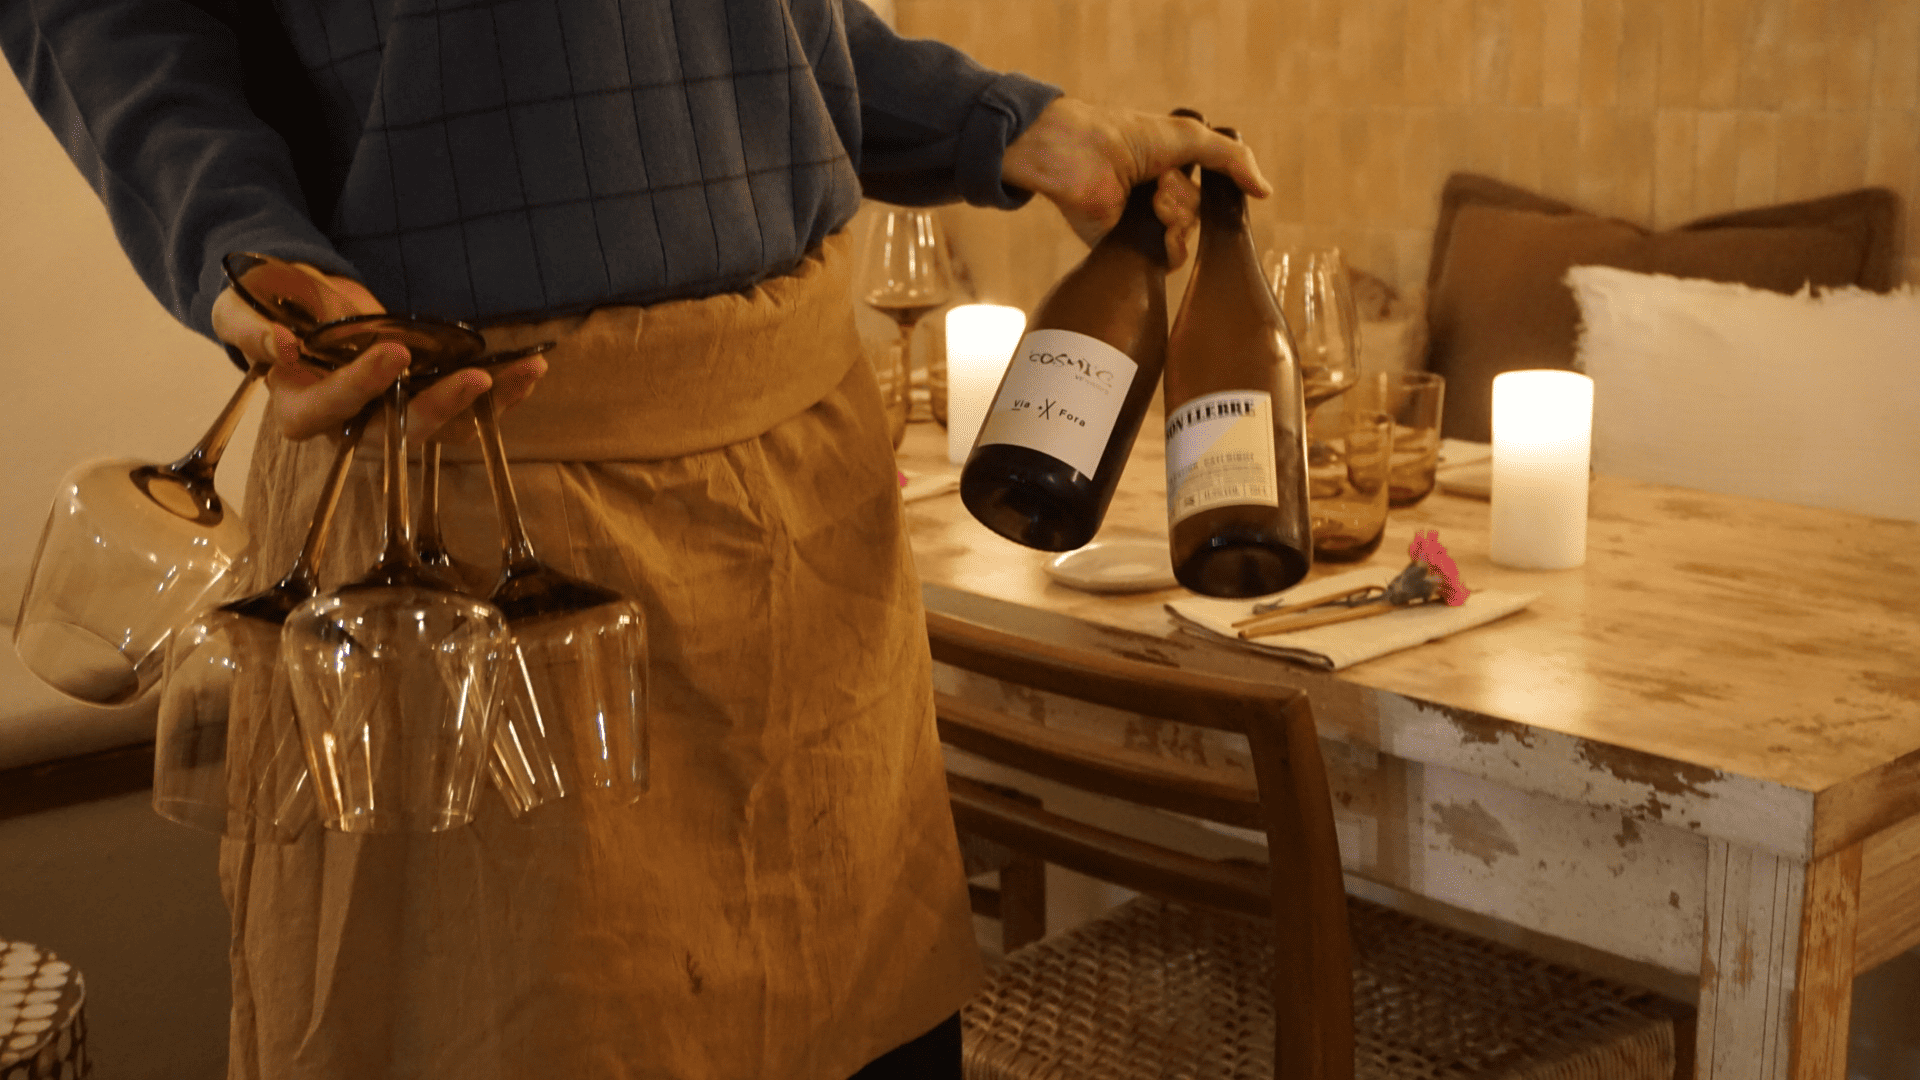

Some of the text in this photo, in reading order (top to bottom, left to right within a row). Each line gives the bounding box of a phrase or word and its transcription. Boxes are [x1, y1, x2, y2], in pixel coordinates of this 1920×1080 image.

[1012, 399, 1031, 411] Via
[1059, 408, 1086, 427] Fora
[1186, 400, 1256, 426] LLEBRE
